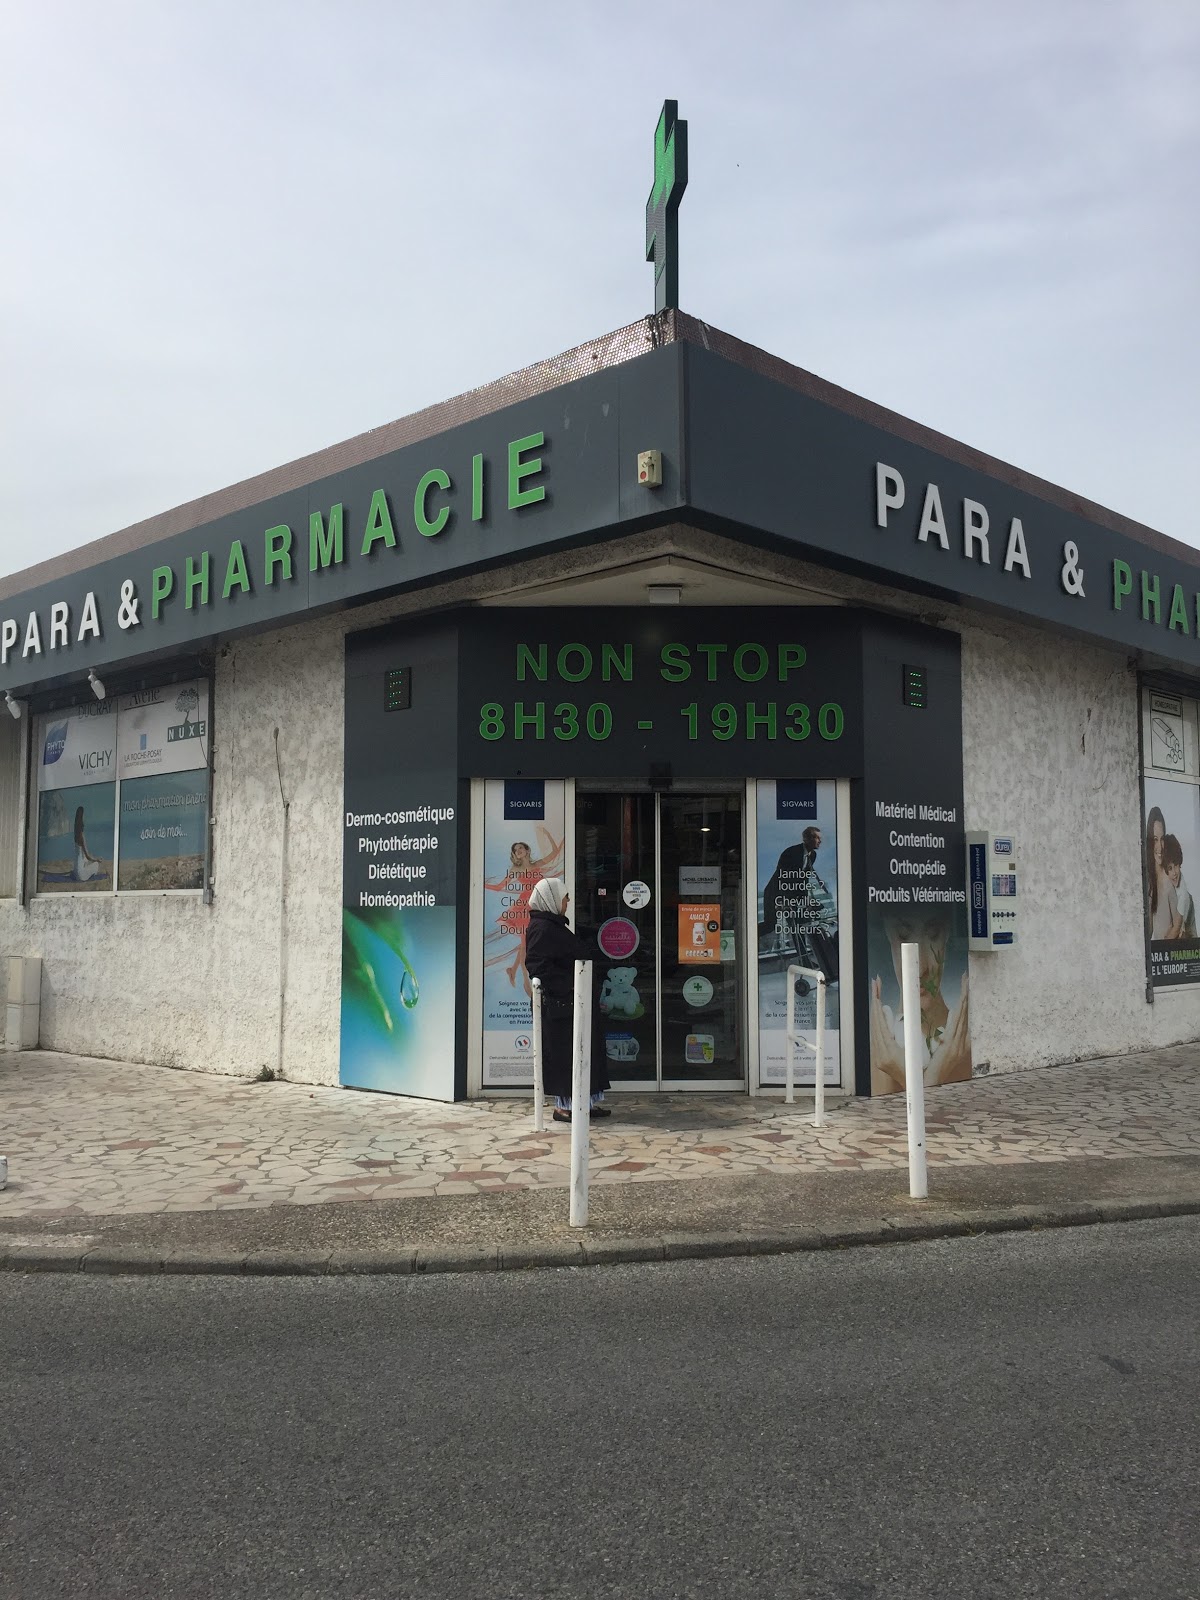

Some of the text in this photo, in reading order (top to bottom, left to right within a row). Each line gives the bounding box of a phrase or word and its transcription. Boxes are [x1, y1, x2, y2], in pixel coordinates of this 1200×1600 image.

[2, 431, 546, 664] PARA & PHARMACIE
[876, 461, 1200, 638] PARA & PHA
[516, 643, 807, 682] NON STOP
[78, 700, 113, 719] DUCRAY
[479, 702, 844, 741] 8H30 - 19H30
[168, 723, 205, 740] NUXE
[47, 739, 65, 750] PHYTO
[79, 749, 113, 770] VICHY
[124, 749, 163, 762] LA ROCHE-POSAY
[509, 800, 543, 808] SIGVARIS
[781, 800, 815, 808] SIGVARIS
[875, 801, 956, 823] Matériel Médical
[346, 805, 455, 827] Dermo-cosmétique
[140, 827, 156, 840] soin
[157, 824, 166, 838] de
[889, 830, 945, 848] Contention
[358, 833, 439, 856] Phytothérapie
[996, 842, 1010, 851] durex
[368, 863, 427, 882] Diététique
[505, 868, 544, 879] Jambes
[778, 868, 817, 879] Jambes
[889, 858, 946, 879] Orthopédie
[778, 880, 825, 891] lourdes ?
[360, 891, 436, 910] Homéopathie
[774, 896, 821, 907] Chevilles
[868, 886, 966, 903] Produits Vétérinaires
[975, 883, 983, 907] durex
[775, 908, 821, 921] gonflées
[774, 924, 822, 935] Douleurs
[1164, 951, 1169, 962] &
